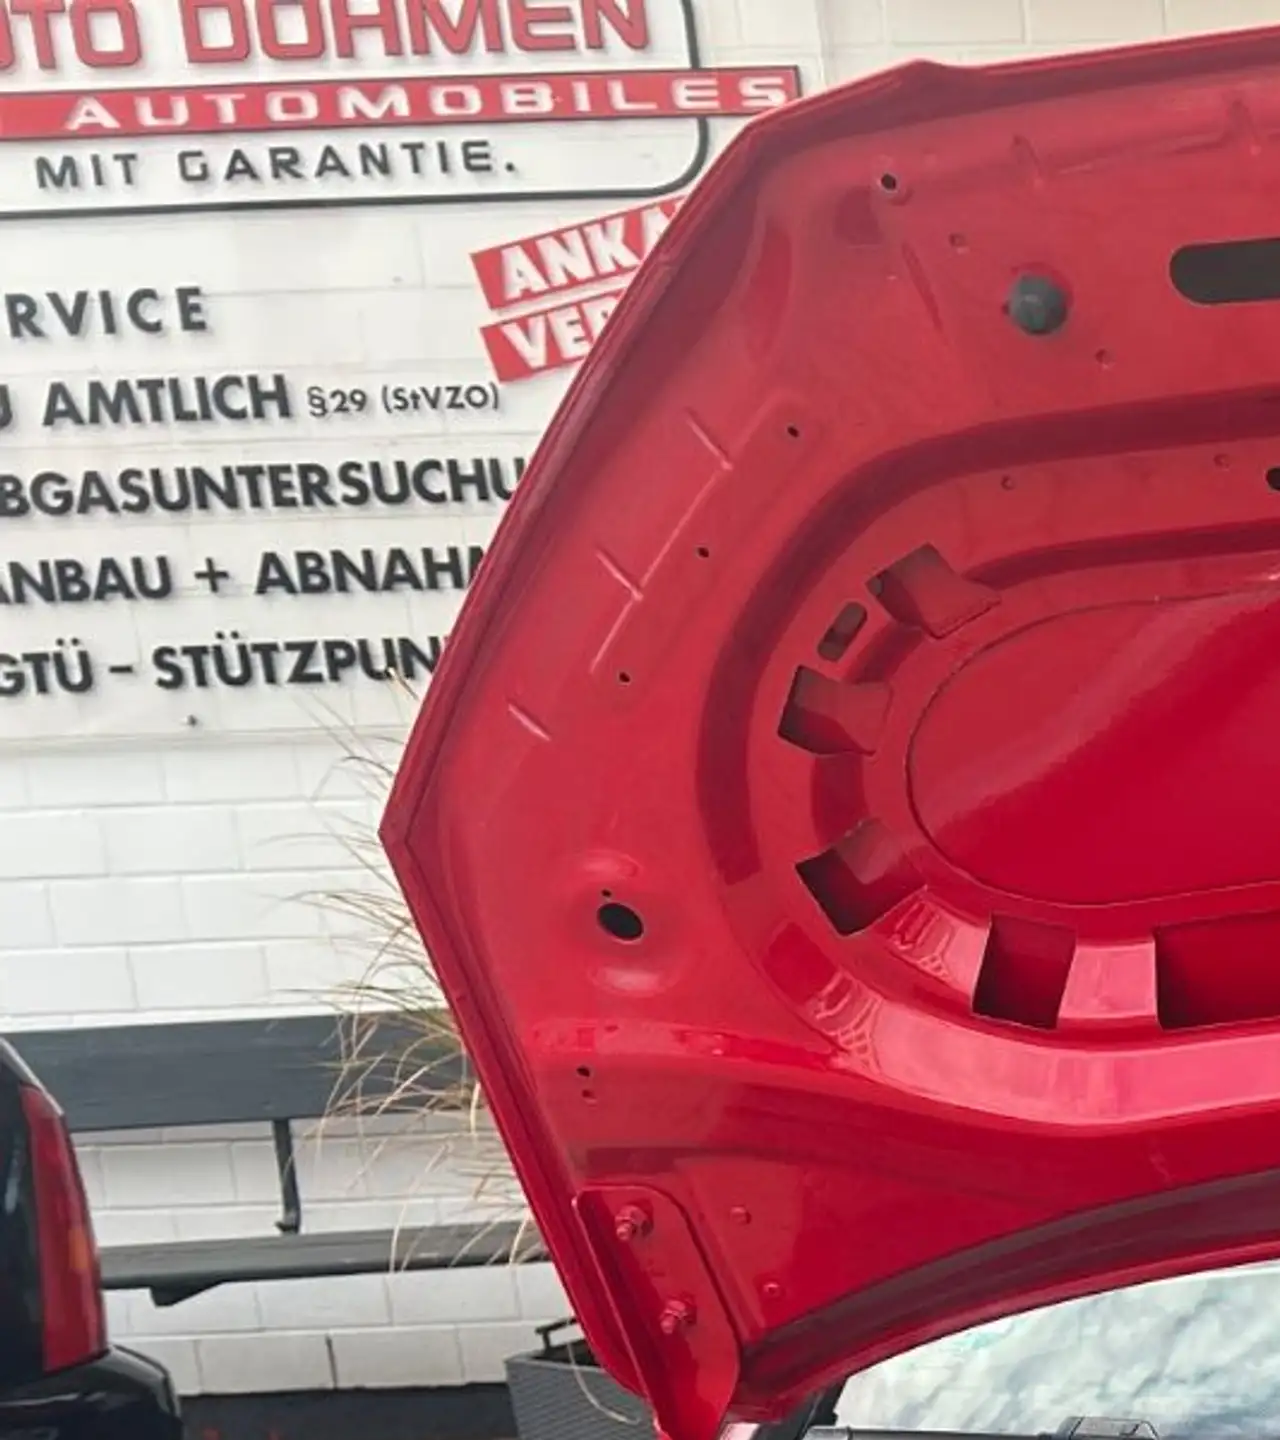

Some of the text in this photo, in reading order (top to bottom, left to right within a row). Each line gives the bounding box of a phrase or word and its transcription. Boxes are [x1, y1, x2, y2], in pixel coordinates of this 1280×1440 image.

[0, 0, 650, 69] TO DOHMEN
[64, 76, 788, 131] AUTOMOBILES
[36, 140, 517, 189] MIT GARANTIE.
[5, 286, 207, 338] RVICE
[42, 373, 292, 427] AMTLICH
[307, 386, 368, 417] §29
[382, 382, 499, 413] (StVZO)
[0, 555, 172, 605] NBAU
[195, 557, 229, 593] +
[152, 631, 447, 690] STÜTZPUN
